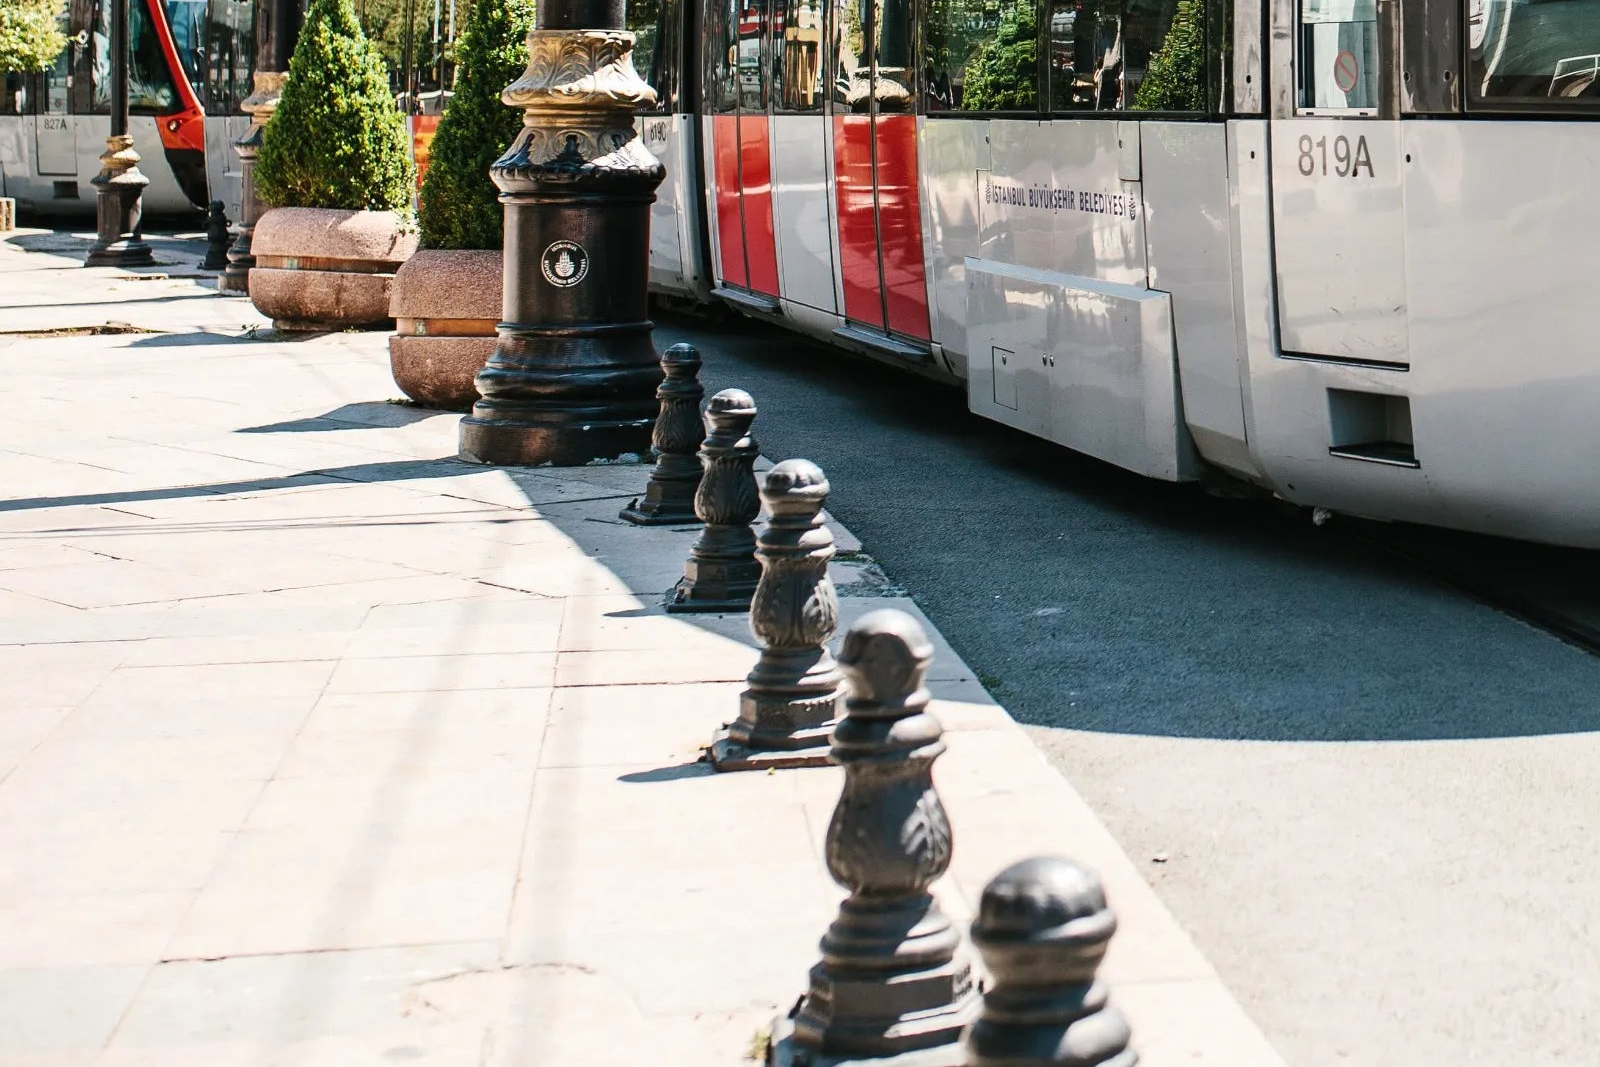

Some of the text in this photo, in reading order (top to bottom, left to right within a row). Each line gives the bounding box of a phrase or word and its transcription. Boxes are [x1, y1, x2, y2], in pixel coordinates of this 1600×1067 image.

[1298, 134, 1375, 177] 819A
[1029, 183, 1076, 215] BÜYÜKŞEHİR
[1079, 187, 1127, 217] BELEDİYESİ
